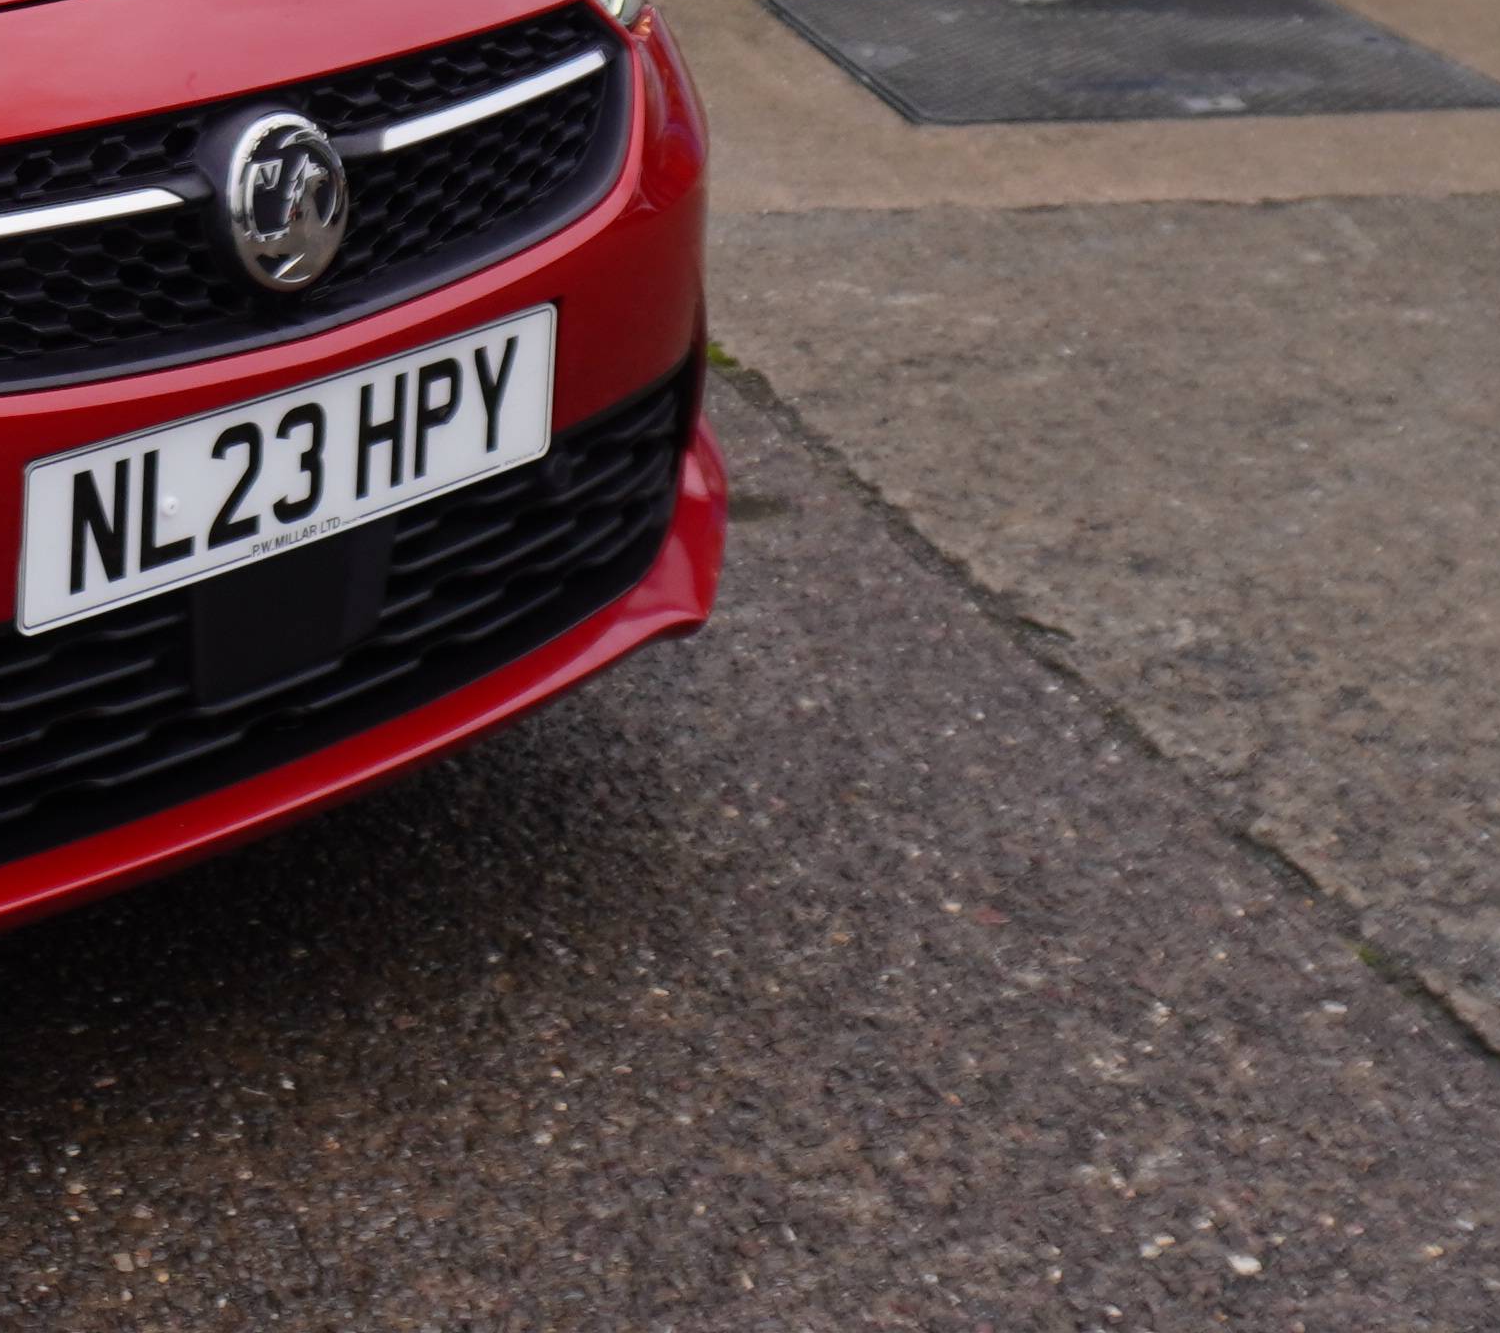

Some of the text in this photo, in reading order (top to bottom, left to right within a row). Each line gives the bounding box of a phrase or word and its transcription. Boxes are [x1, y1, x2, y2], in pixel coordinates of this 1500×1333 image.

[70, 337, 519, 595] NL23 HPY
[319, 516, 342, 536] LTD
